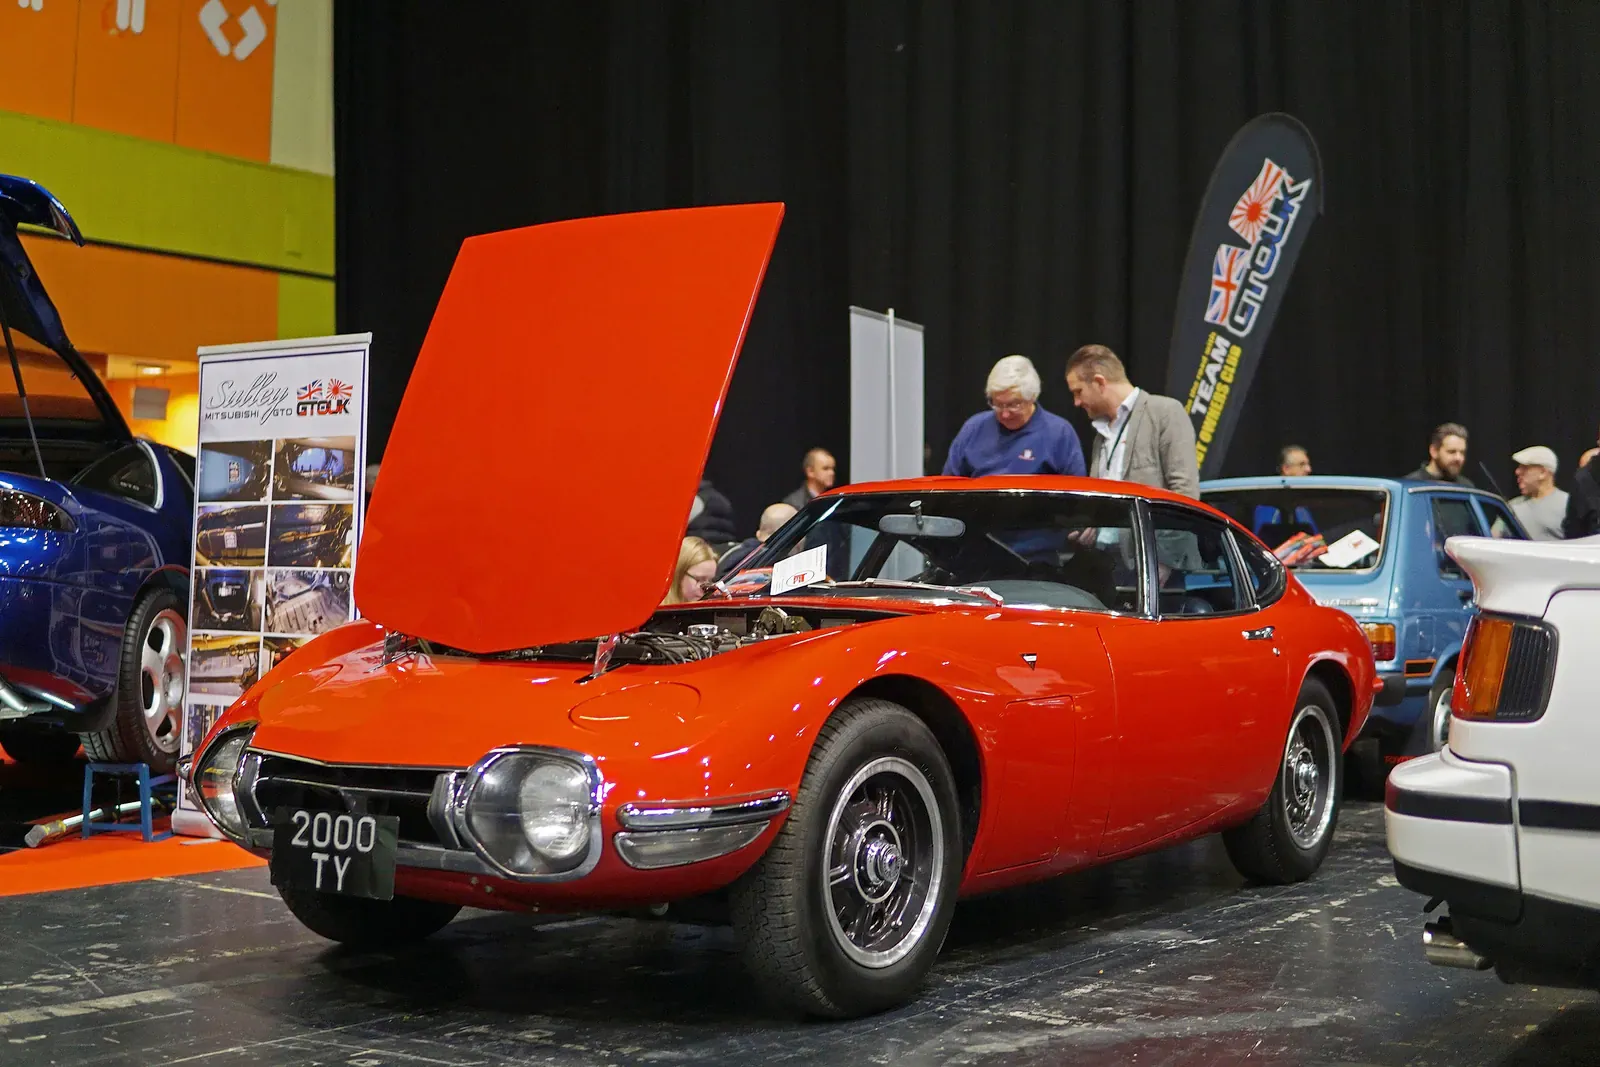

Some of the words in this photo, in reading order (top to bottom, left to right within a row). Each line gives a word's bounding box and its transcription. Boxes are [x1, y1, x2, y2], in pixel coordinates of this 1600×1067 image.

[1191, 335, 1231, 415] TEAM
[1199, 382, 1230, 443] OWNERS
[1220, 344, 1242, 384] CLUB
[205, 410, 259, 420] MITSUBISHI
[272, 408, 293, 417] GTO
[291, 810, 377, 853] 2000
[311, 852, 351, 892] TY
